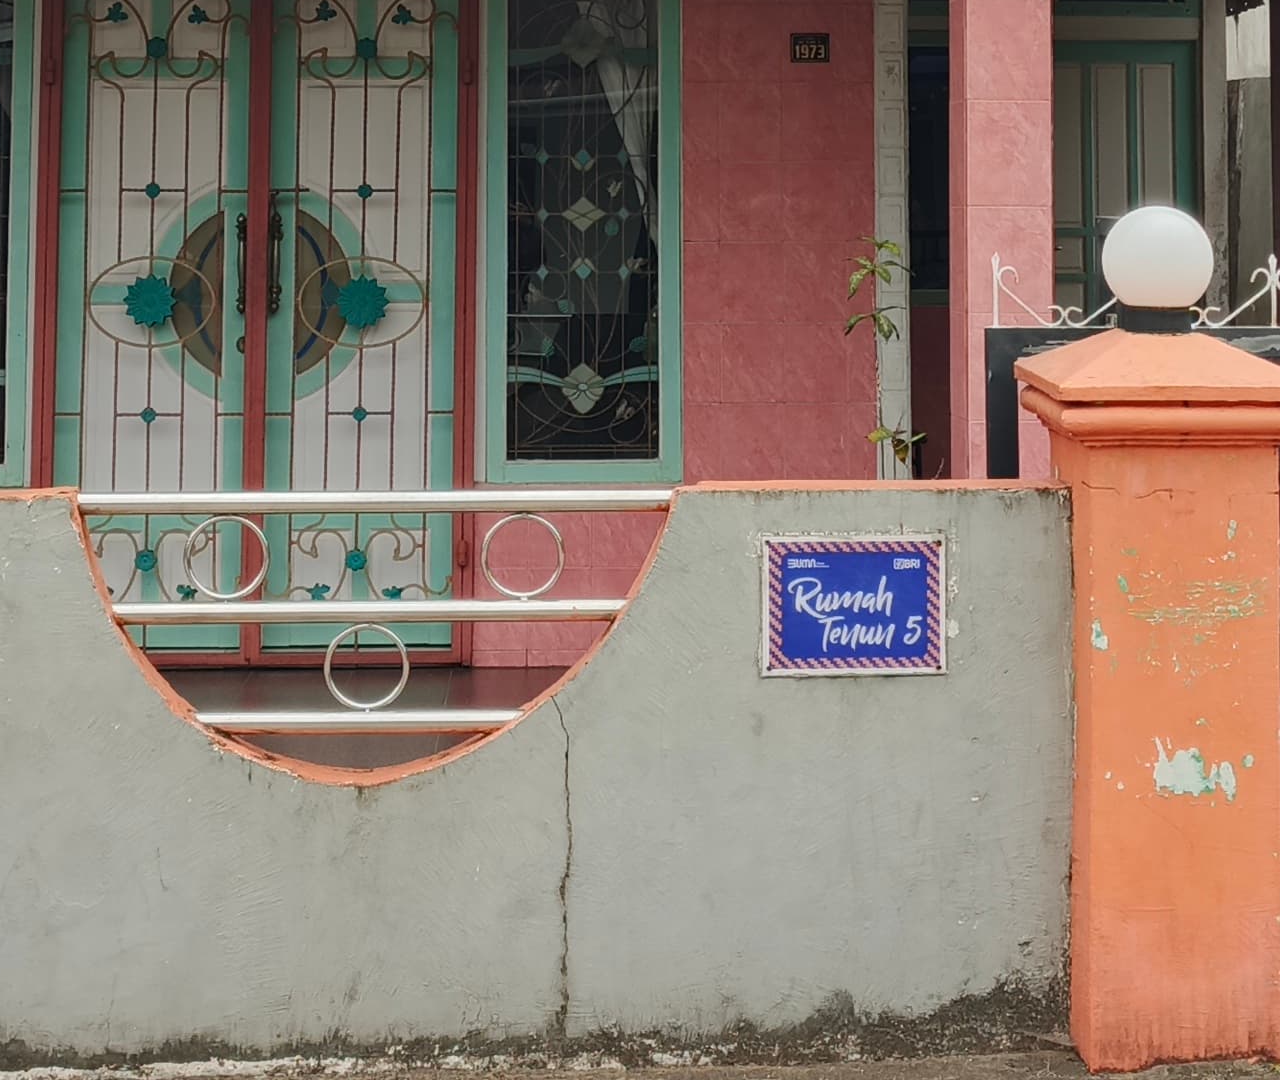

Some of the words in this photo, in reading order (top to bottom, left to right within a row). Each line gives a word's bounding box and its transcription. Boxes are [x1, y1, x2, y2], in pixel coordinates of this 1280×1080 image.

[795, 44, 825, 59] 1973
[788, 575, 893, 618] Rumah
[818, 616, 896, 652] Tenun
[903, 615, 923, 645] 5
